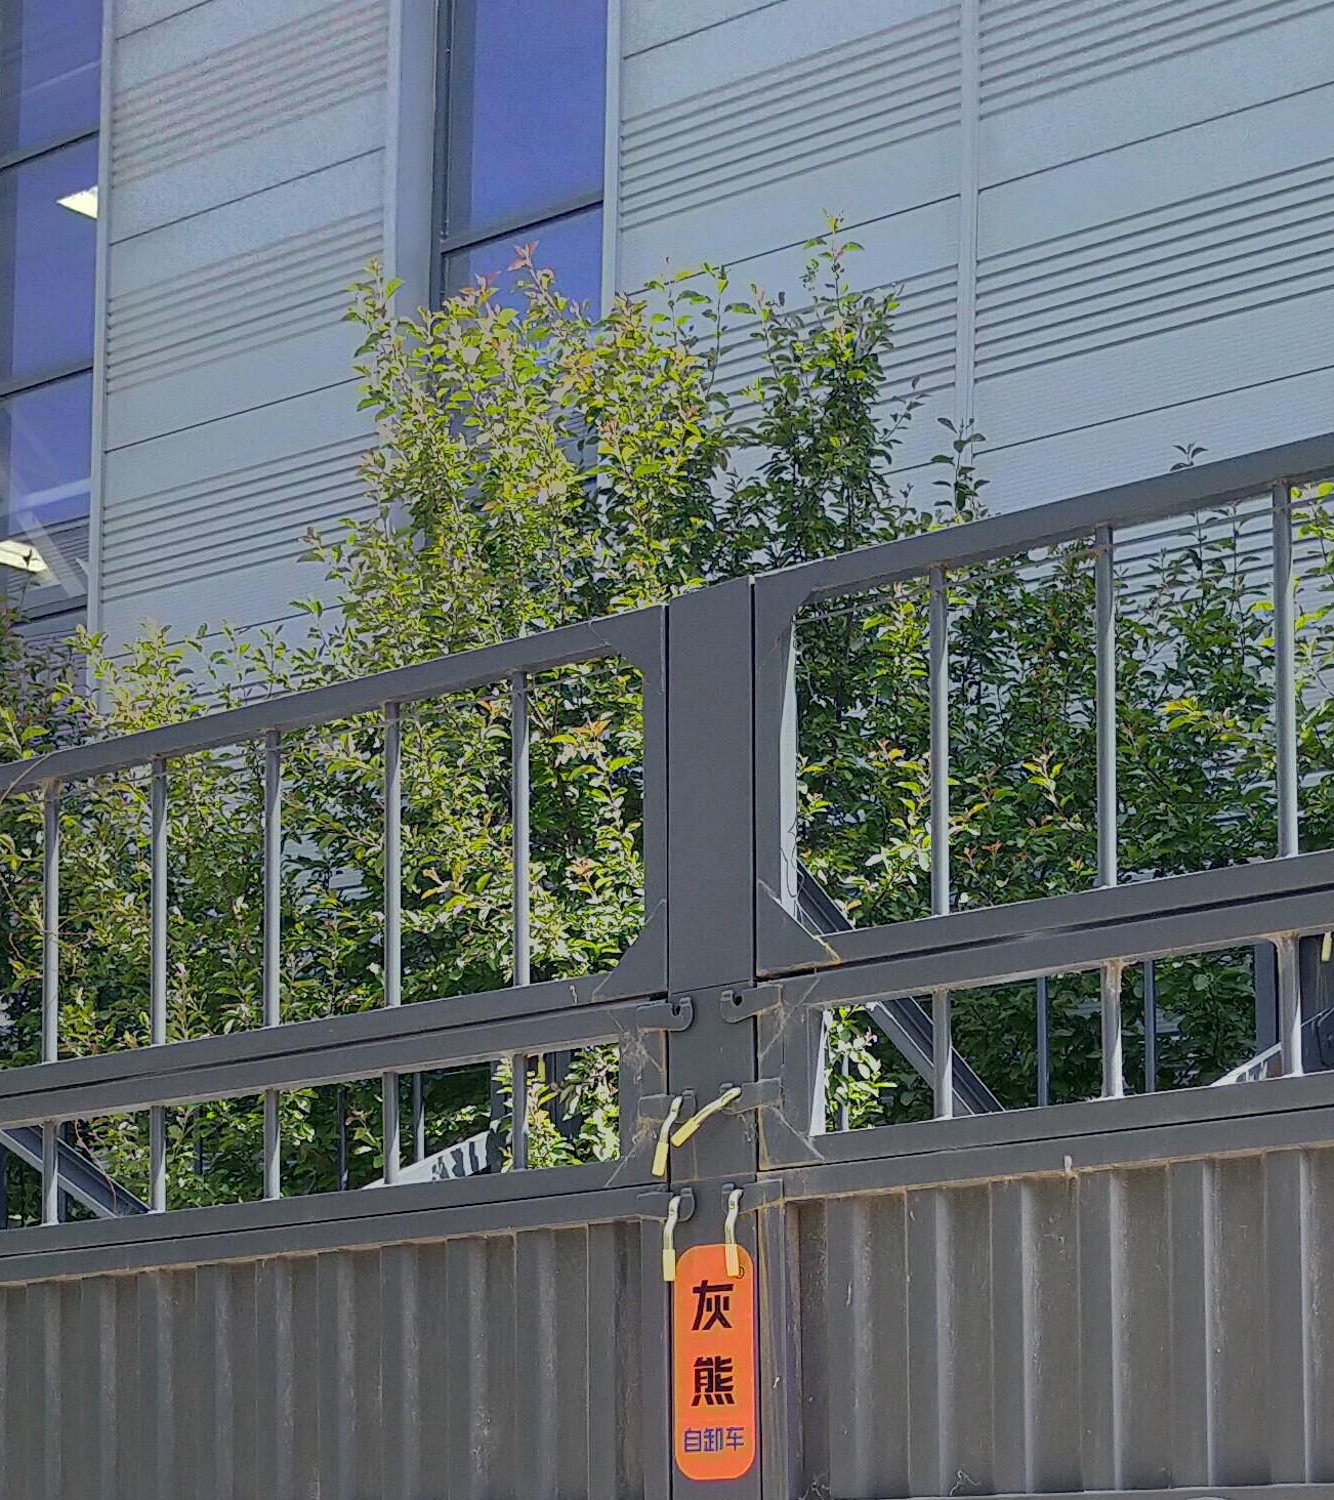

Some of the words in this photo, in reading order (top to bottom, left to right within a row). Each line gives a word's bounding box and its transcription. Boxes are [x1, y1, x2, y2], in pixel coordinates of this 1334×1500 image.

[691, 1279, 736, 1407] 灰熊
[683, 1426, 745, 1453] 自卸车
